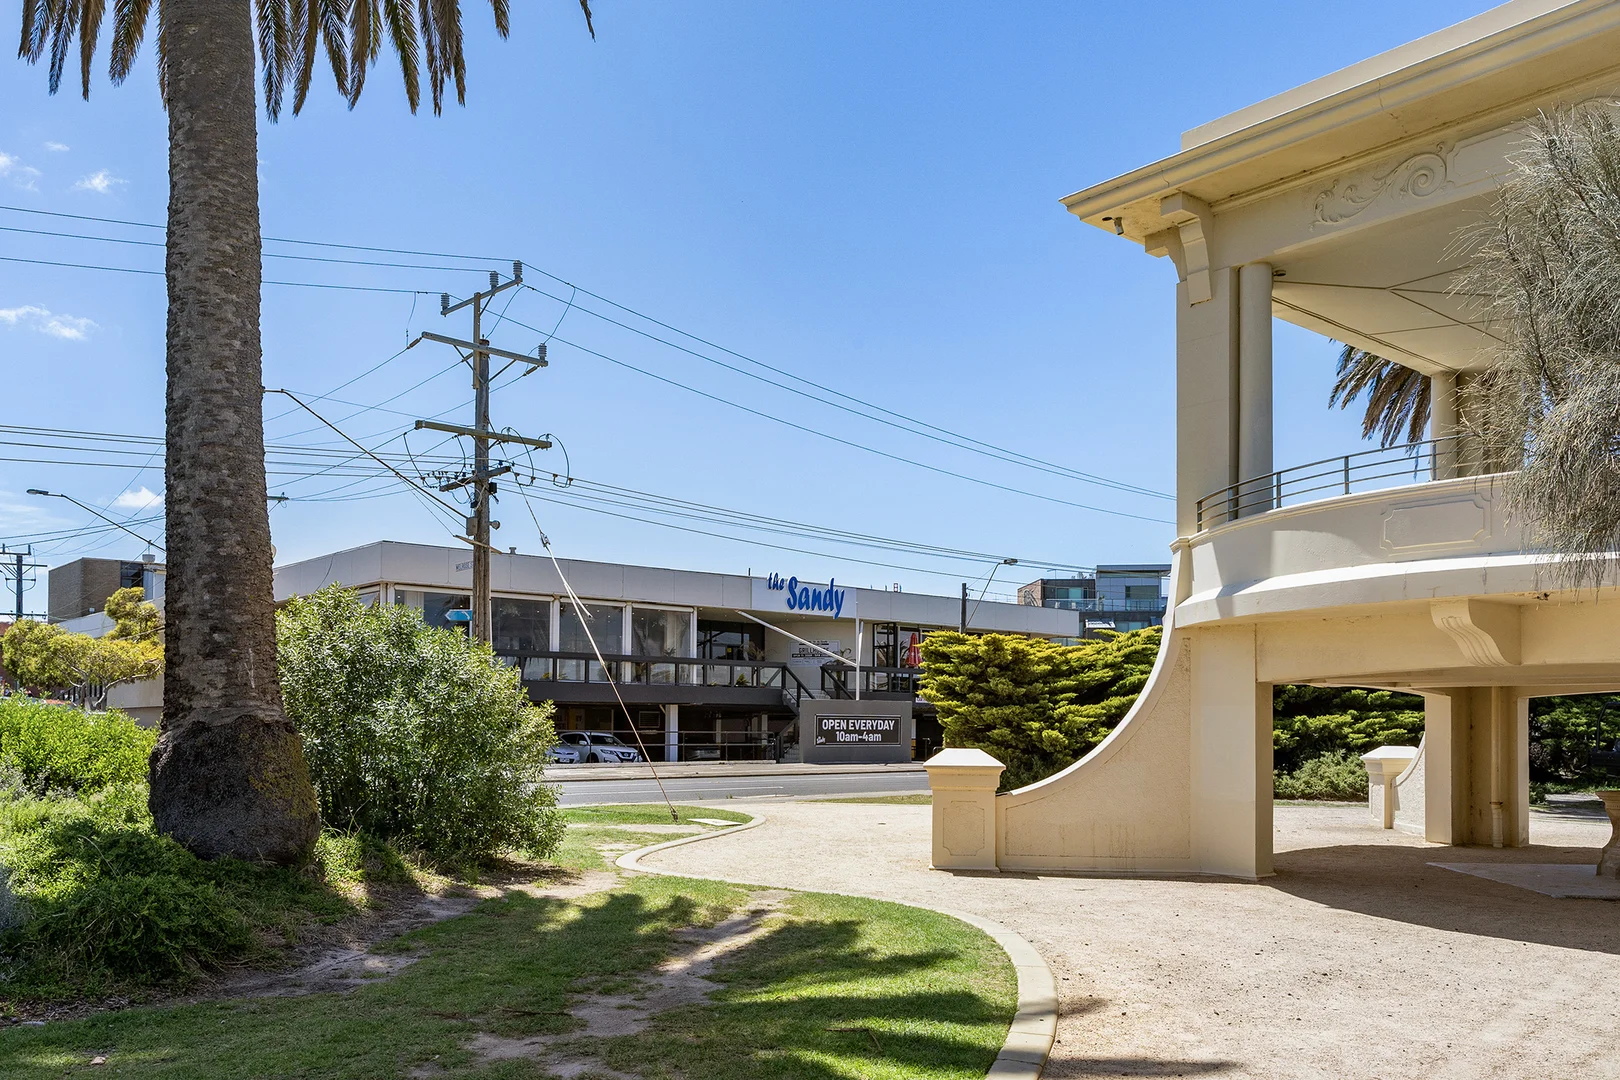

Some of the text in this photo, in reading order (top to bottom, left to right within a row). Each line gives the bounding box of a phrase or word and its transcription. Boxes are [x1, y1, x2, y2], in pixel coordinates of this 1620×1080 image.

[767, 572, 845, 620] the Sandy
[822, 719, 895, 730] OPEN EVERYDAY
[835, 731, 882, 742] 10am-4am
